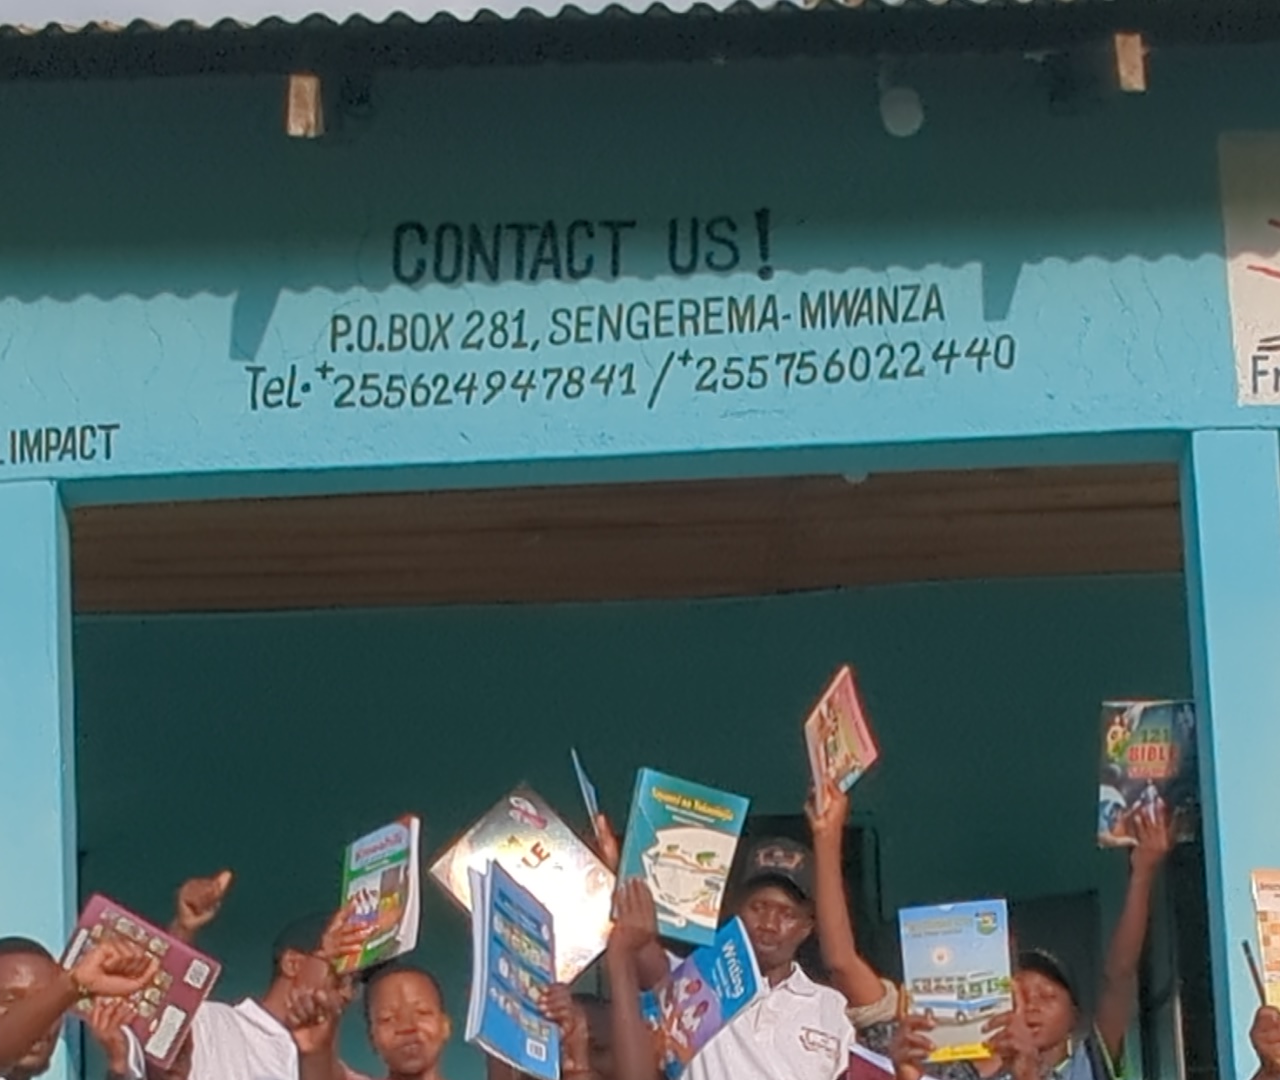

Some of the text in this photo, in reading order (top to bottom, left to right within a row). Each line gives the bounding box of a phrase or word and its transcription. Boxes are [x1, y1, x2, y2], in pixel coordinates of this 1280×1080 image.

[392, 207, 775, 285] CONTACT US!
[9, 424, 121, 463] IMPACT
